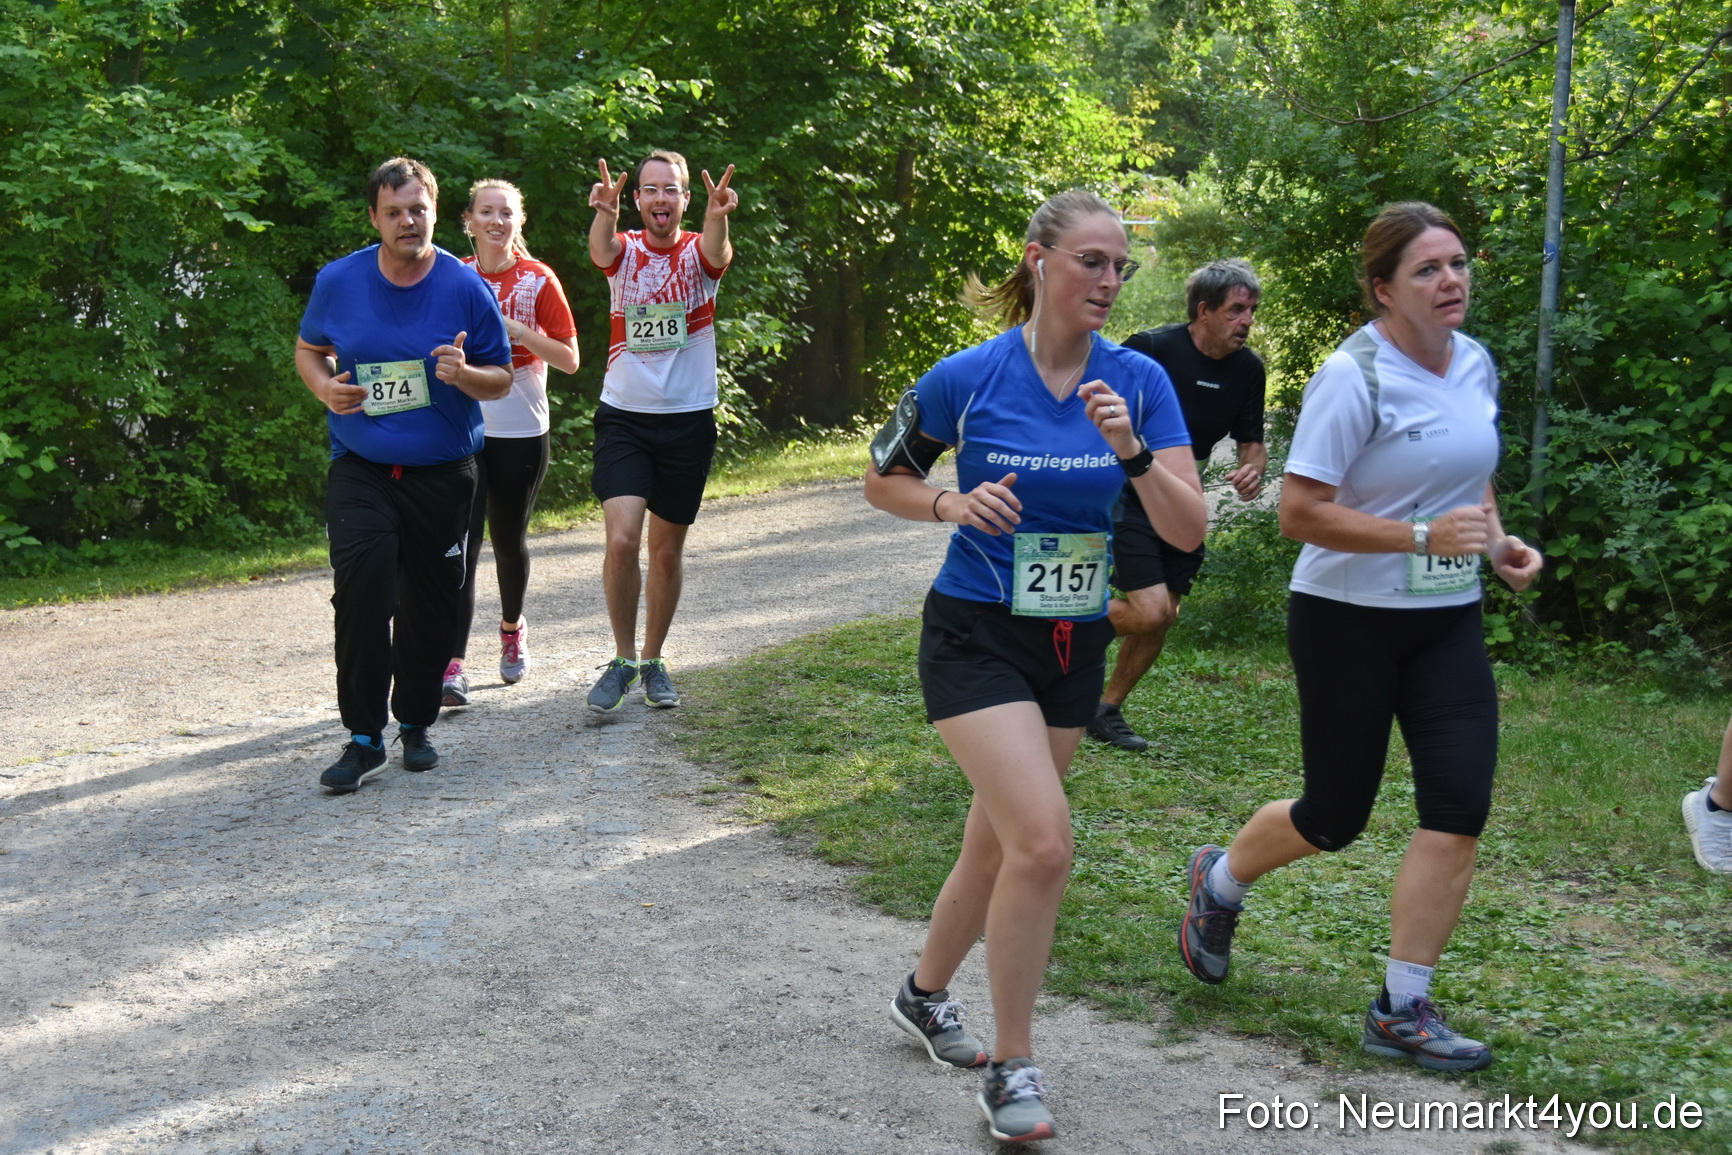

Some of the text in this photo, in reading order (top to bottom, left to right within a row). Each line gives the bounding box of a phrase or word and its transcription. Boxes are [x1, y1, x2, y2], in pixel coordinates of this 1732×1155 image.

[632, 319, 678, 338] 2218
[372, 380, 412, 401] 874
[1027, 563, 1098, 592] 2157
